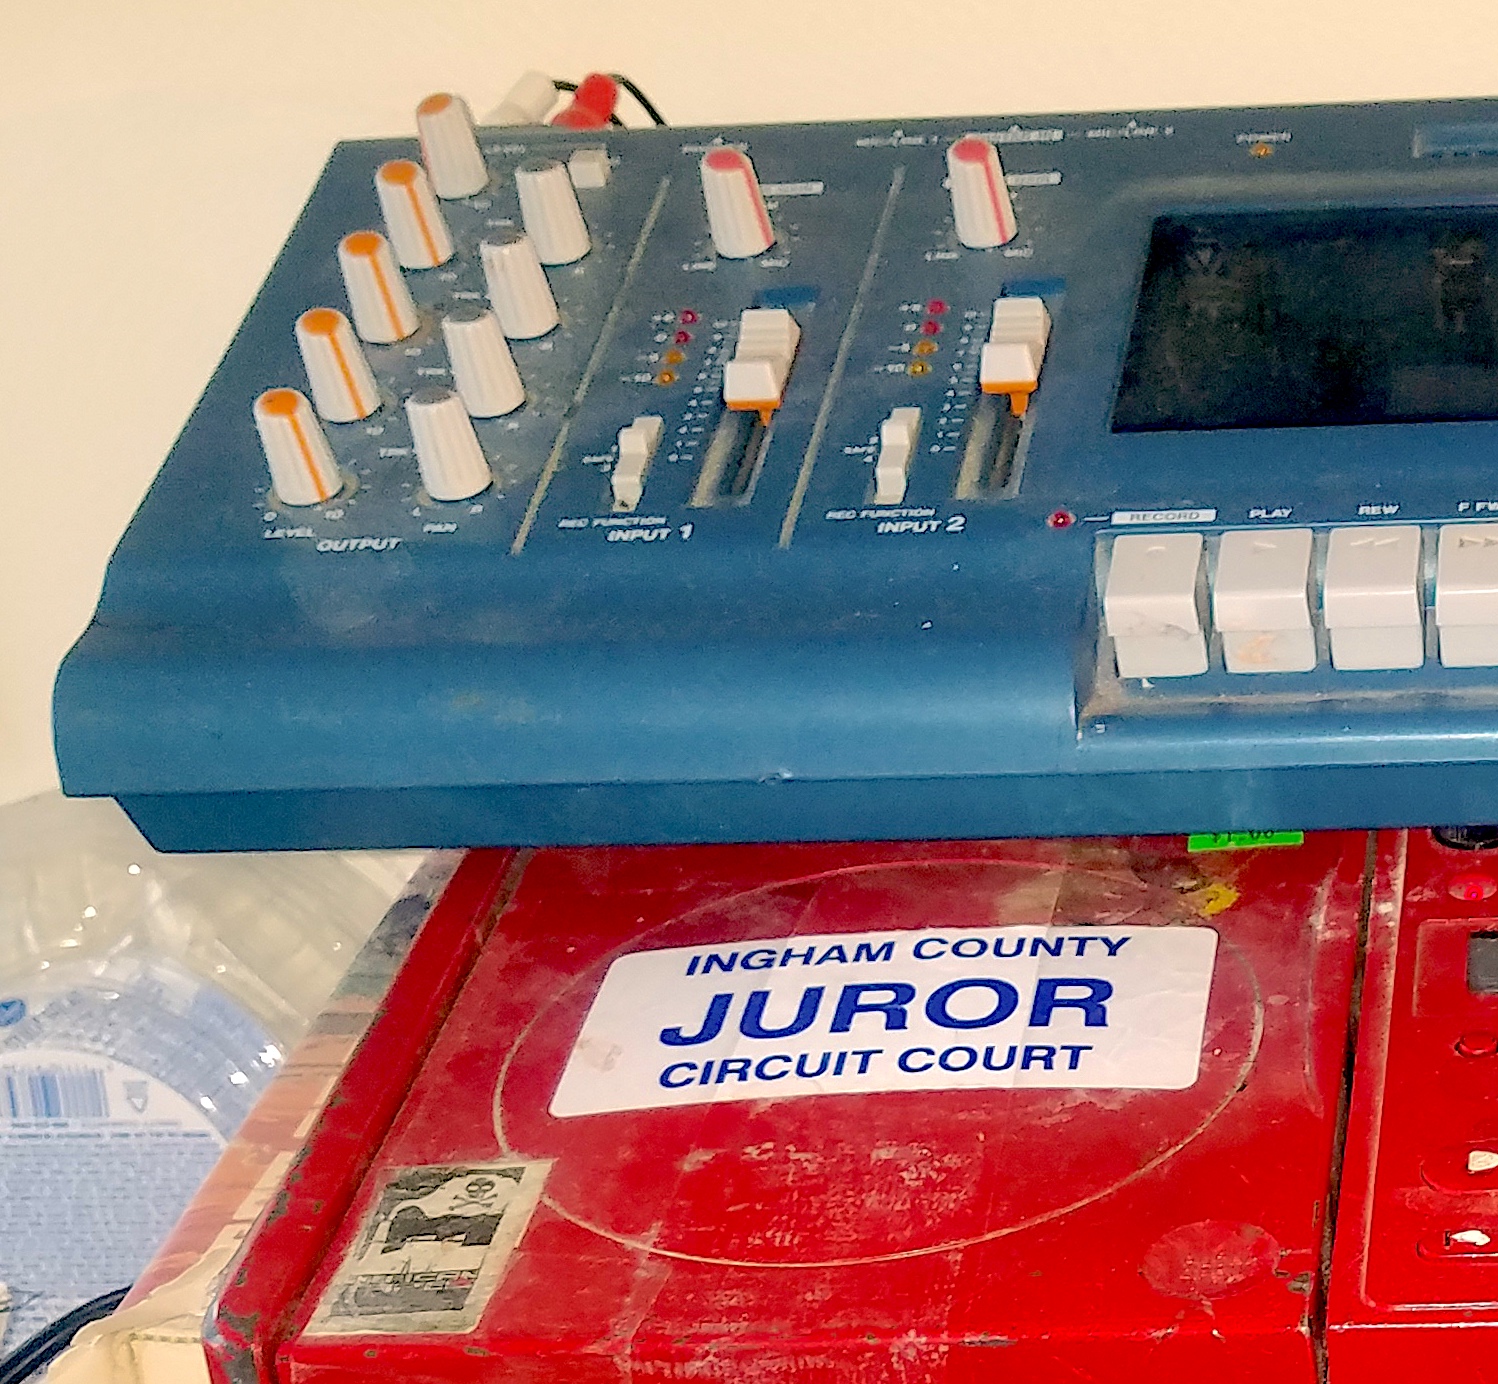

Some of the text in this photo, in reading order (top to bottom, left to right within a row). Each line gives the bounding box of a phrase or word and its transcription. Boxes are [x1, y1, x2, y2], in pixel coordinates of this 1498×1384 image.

[1249, 507, 1292, 519] PLAY
[1358, 503, 1400, 515] REW
[1458, 501, 1469, 512] F
[1129, 510, 1201, 522] RECORD
[606, 523, 695, 542] INPUT 1
[876, 515, 966, 534] INPUT 2
[264, 527, 316, 540] LEVEL
[316, 536, 403, 552] OUTPUT
[686, 935, 1133, 977] INGHAM COUNTY
[659, 977, 1115, 1049] JUROR
[657, 1044, 1094, 1090] CIRCUIT COURT
